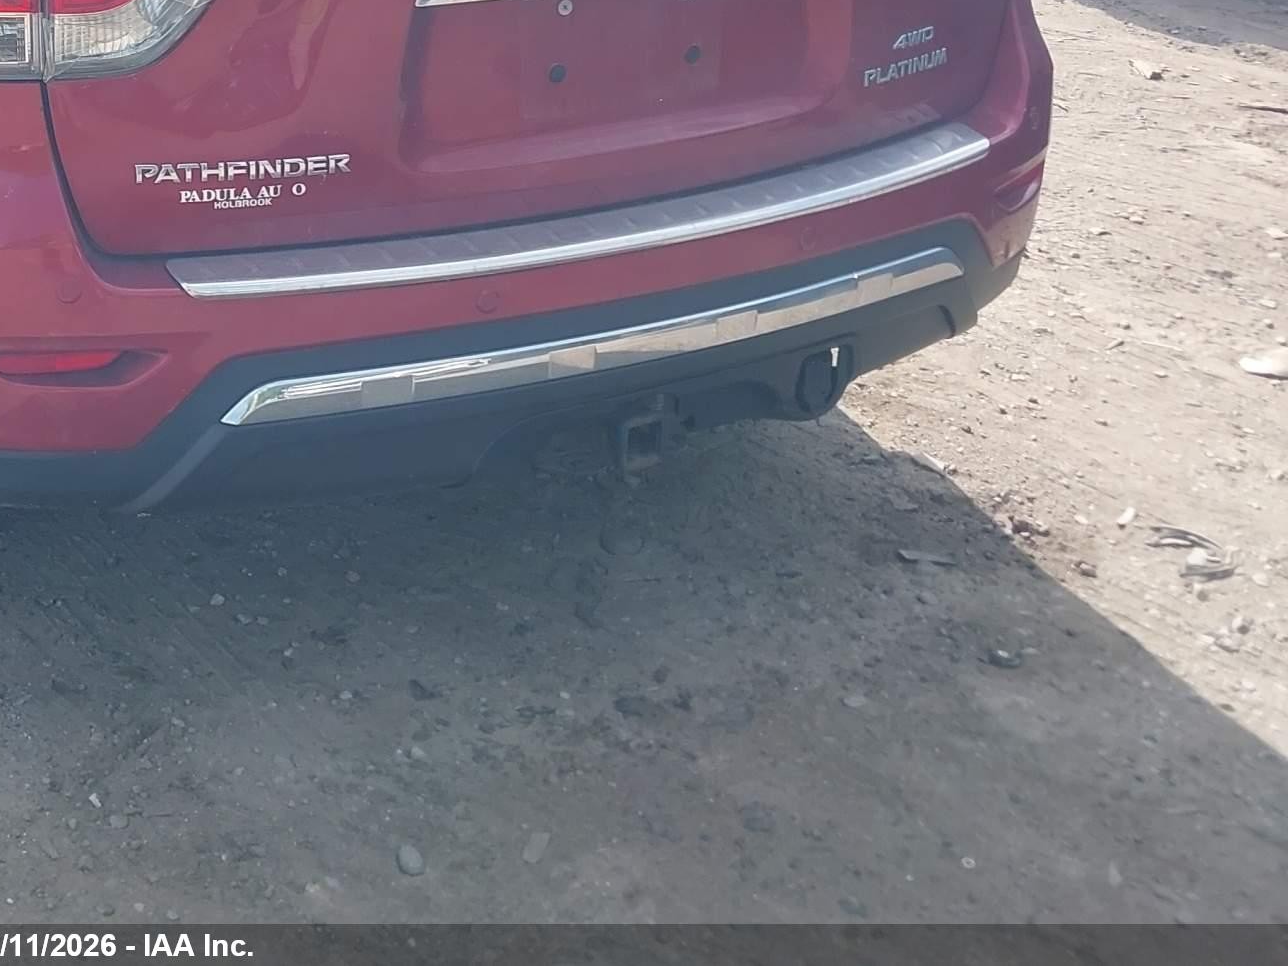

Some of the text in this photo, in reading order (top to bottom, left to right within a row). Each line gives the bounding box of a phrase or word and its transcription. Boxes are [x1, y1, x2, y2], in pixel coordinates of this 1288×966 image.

[892, 25, 934, 49] 4WD
[863, 47, 948, 87] PLATINUM
[134, 153, 352, 184] PATHFINDER
[180, 187, 252, 203] PADULA
[214, 198, 273, 210] HOLBROOK
